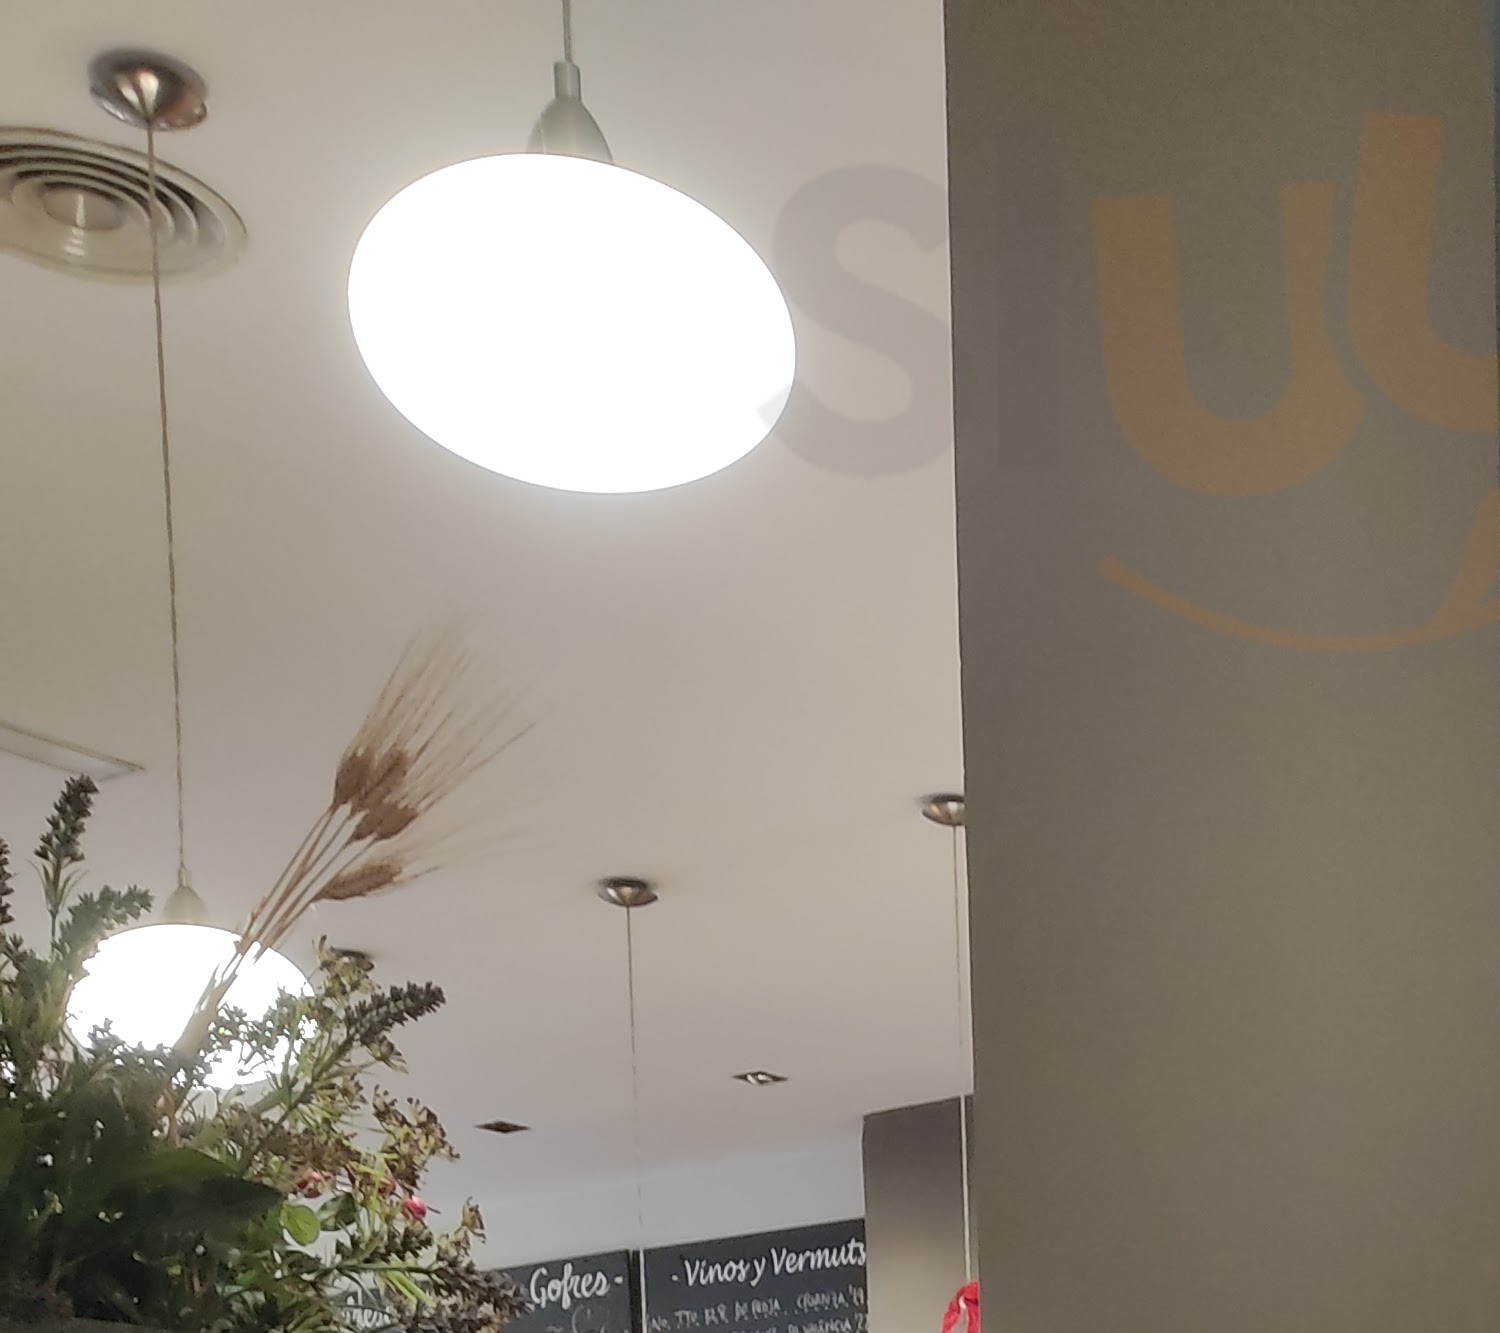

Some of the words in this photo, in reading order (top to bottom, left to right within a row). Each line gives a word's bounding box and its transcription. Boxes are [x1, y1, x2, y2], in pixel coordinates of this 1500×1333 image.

[684, 1257, 750, 1287] Vinos
[750, 1256, 766, 1287] y
[770, 1238, 867, 1276] Vermuts
